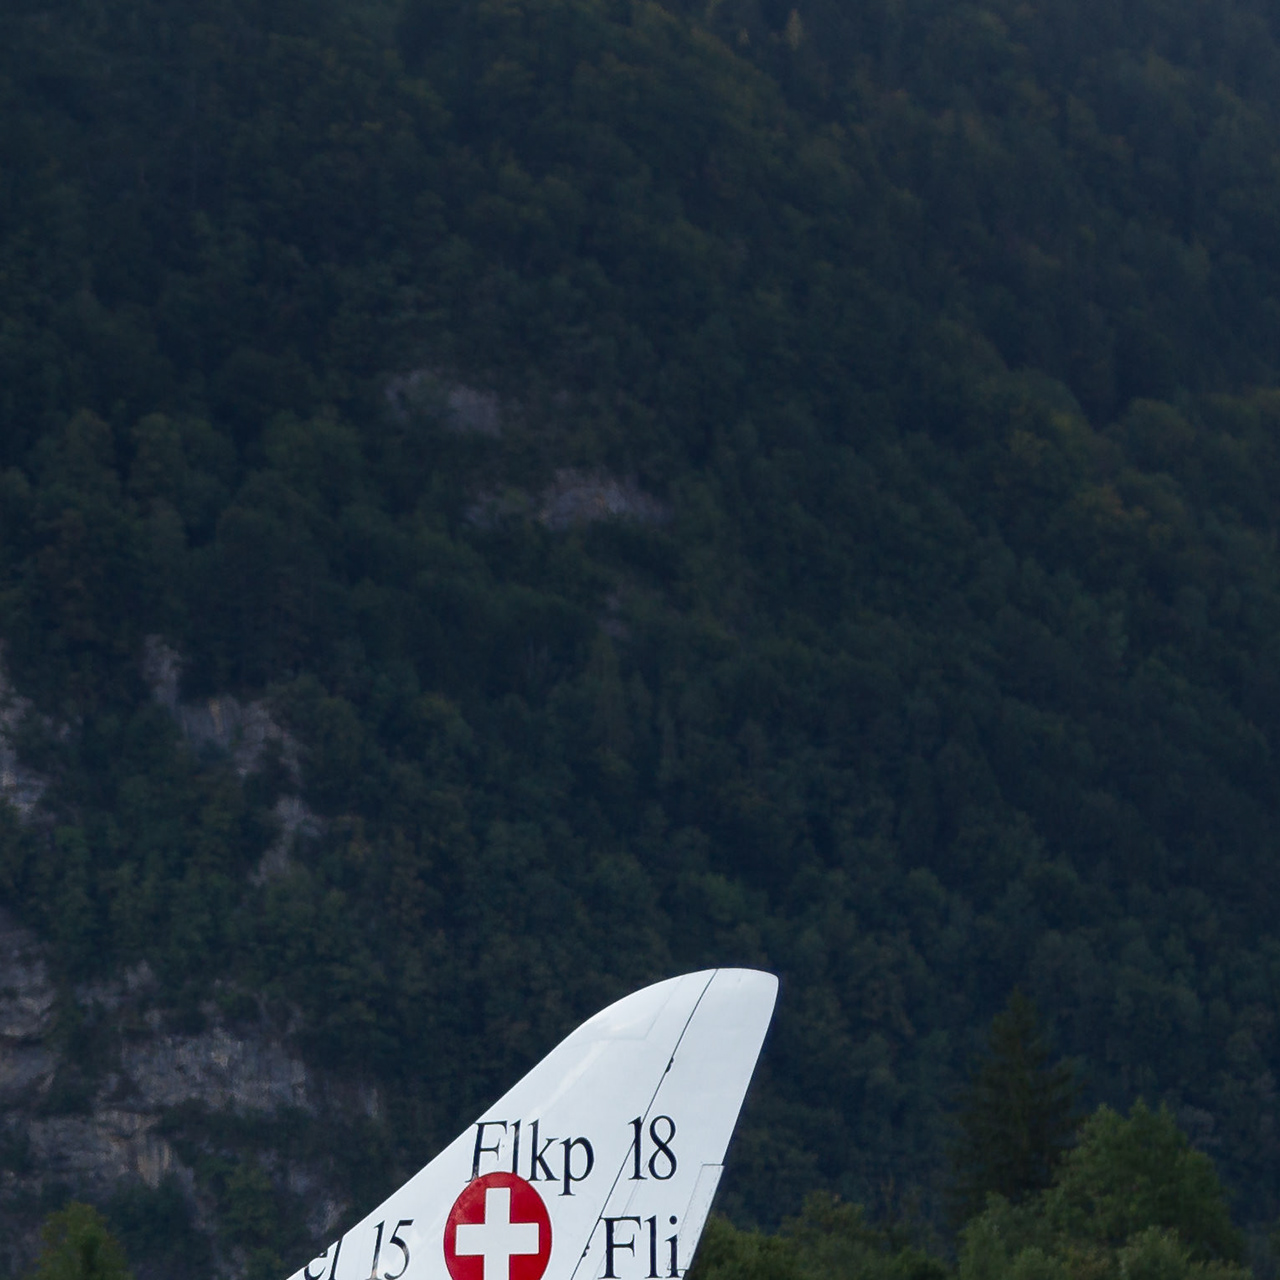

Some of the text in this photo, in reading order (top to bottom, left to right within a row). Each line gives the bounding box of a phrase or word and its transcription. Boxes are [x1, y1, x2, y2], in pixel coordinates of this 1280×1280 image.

[465, 1114, 678, 1196] Flkp 18
[597, 1214, 684, 1280] Fli
